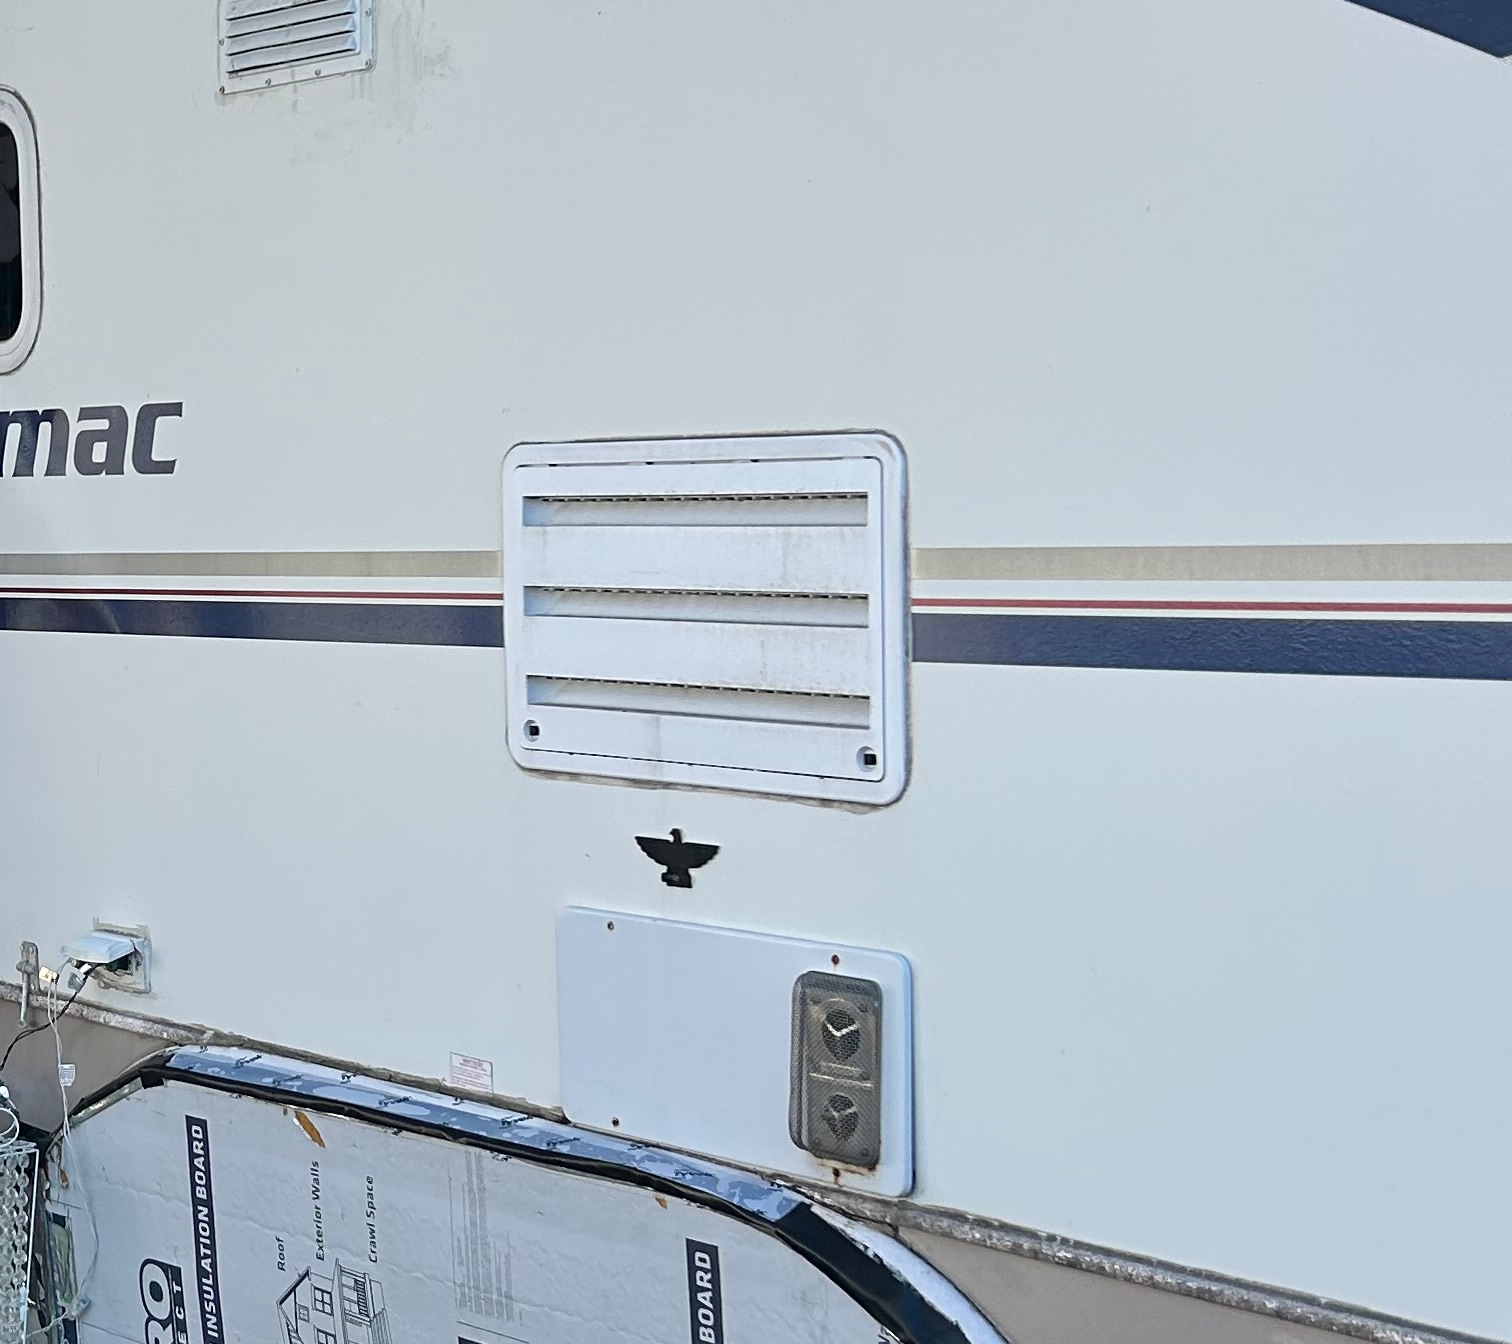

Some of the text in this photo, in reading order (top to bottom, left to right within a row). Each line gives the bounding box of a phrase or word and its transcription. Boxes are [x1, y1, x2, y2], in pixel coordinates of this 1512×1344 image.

[191, 1124, 208, 1200] BOARD
[275, 1235, 286, 1272] Roof
[309, 1159, 325, 1262] Exterior Walls
[365, 1175, 378, 1264] Crawl Space
[197, 1204, 219, 1338] INSULATION
[694, 1250, 718, 1344] BOARD
